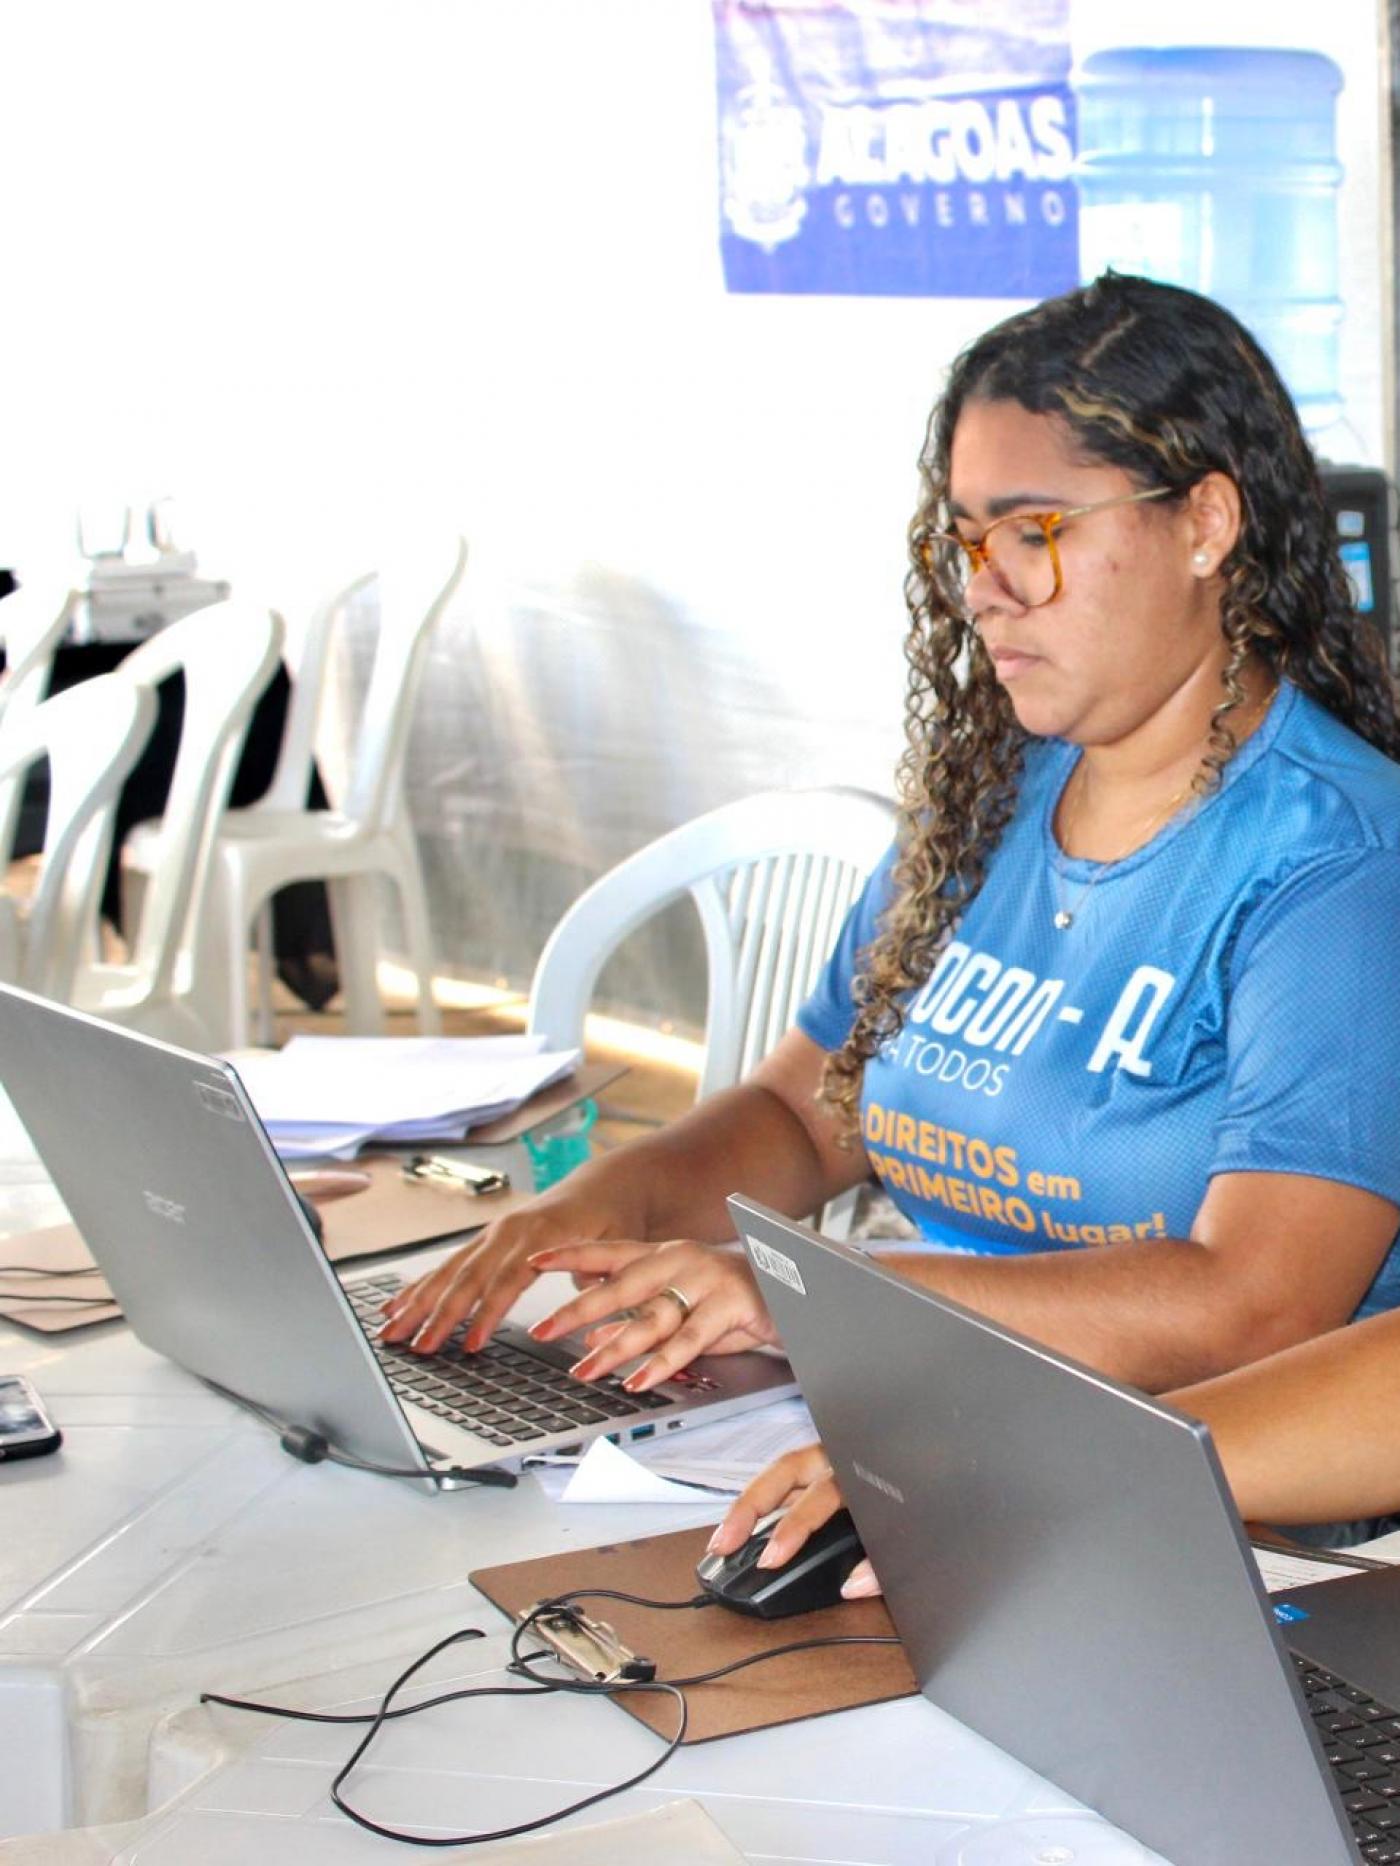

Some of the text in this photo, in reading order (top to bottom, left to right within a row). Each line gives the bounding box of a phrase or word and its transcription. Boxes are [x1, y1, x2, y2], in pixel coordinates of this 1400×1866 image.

[834, 190, 1066, 228] GOVERNO
[903, 1033, 1010, 1097] TODOS
[866, 1102, 1081, 1201] DIREITOS em
[867, 1149, 1168, 1245] PRIMEIRO lugar!
